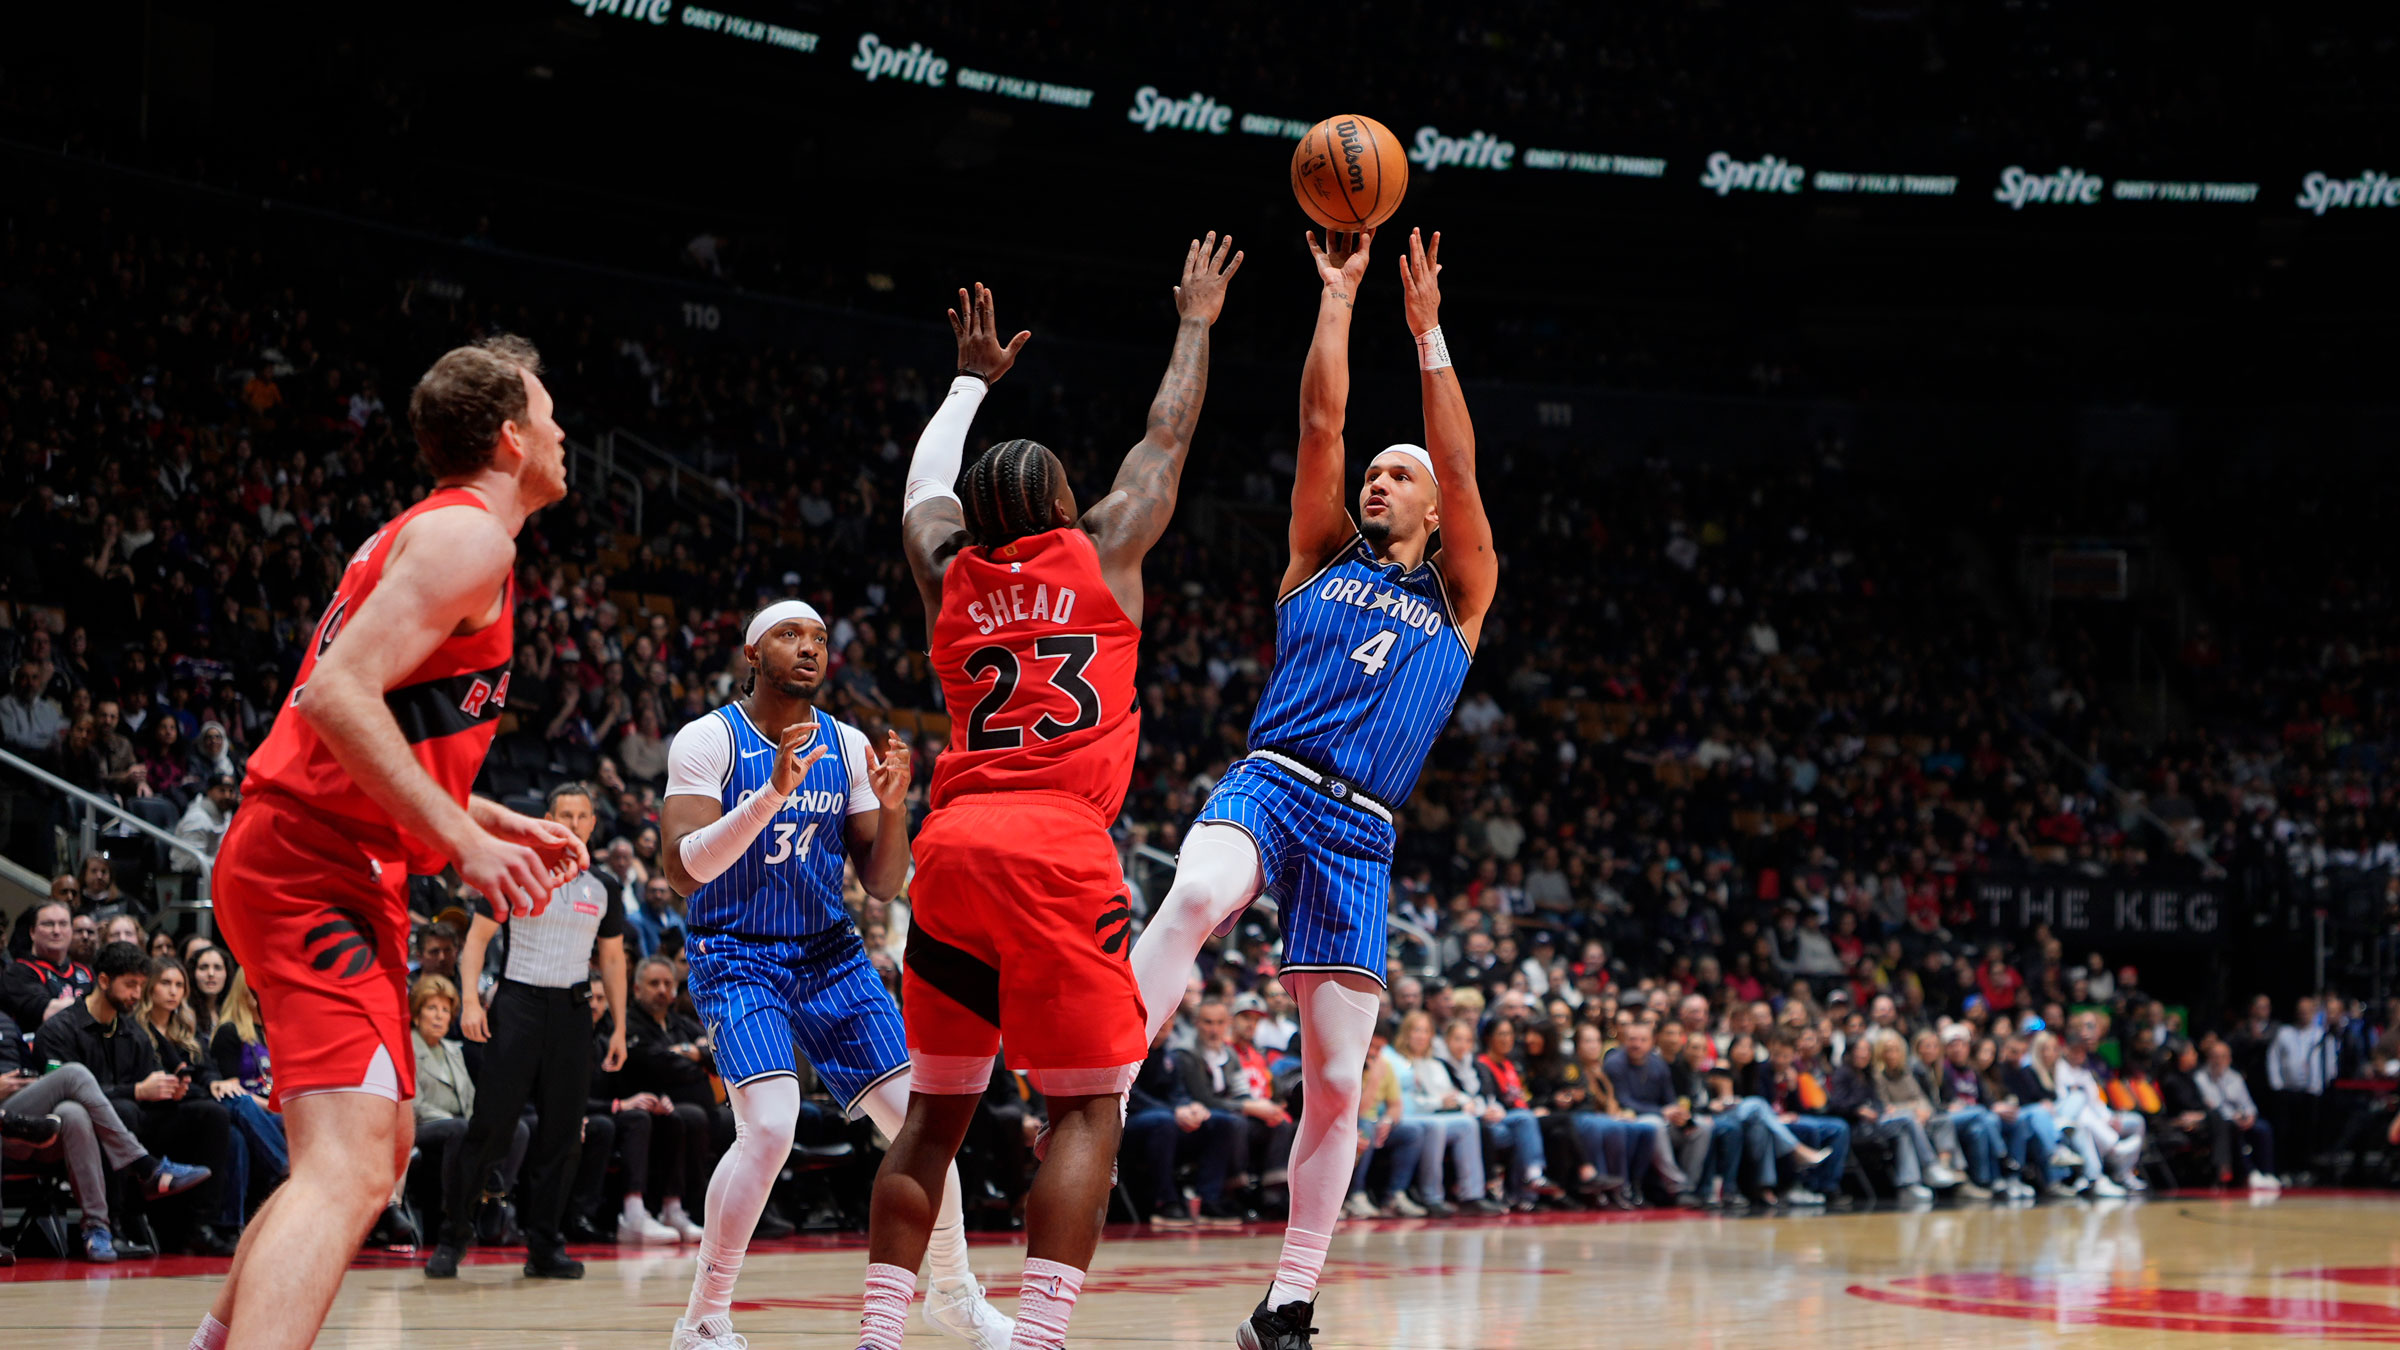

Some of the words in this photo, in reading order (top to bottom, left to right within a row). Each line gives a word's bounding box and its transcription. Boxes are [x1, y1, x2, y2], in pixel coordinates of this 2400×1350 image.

[851, 33, 949, 87] Sprite
[1128, 86, 1233, 134] Sprite
[1336, 120, 1366, 195] Wilson
[1409, 126, 1515, 171] Sprite
[1701, 151, 1805, 196] Sprite
[1994, 165, 2103, 210] Sprite
[2296, 170, 2400, 215] Sprite
[681, 301, 721, 331] 110
[967, 583, 1076, 635] SHEAD
[1350, 628, 1400, 677] 4
[962, 633, 1101, 752] 23
[764, 822, 820, 865] 34
[1979, 886, 2090, 929] THE
[2114, 888, 2219, 932] KEG
